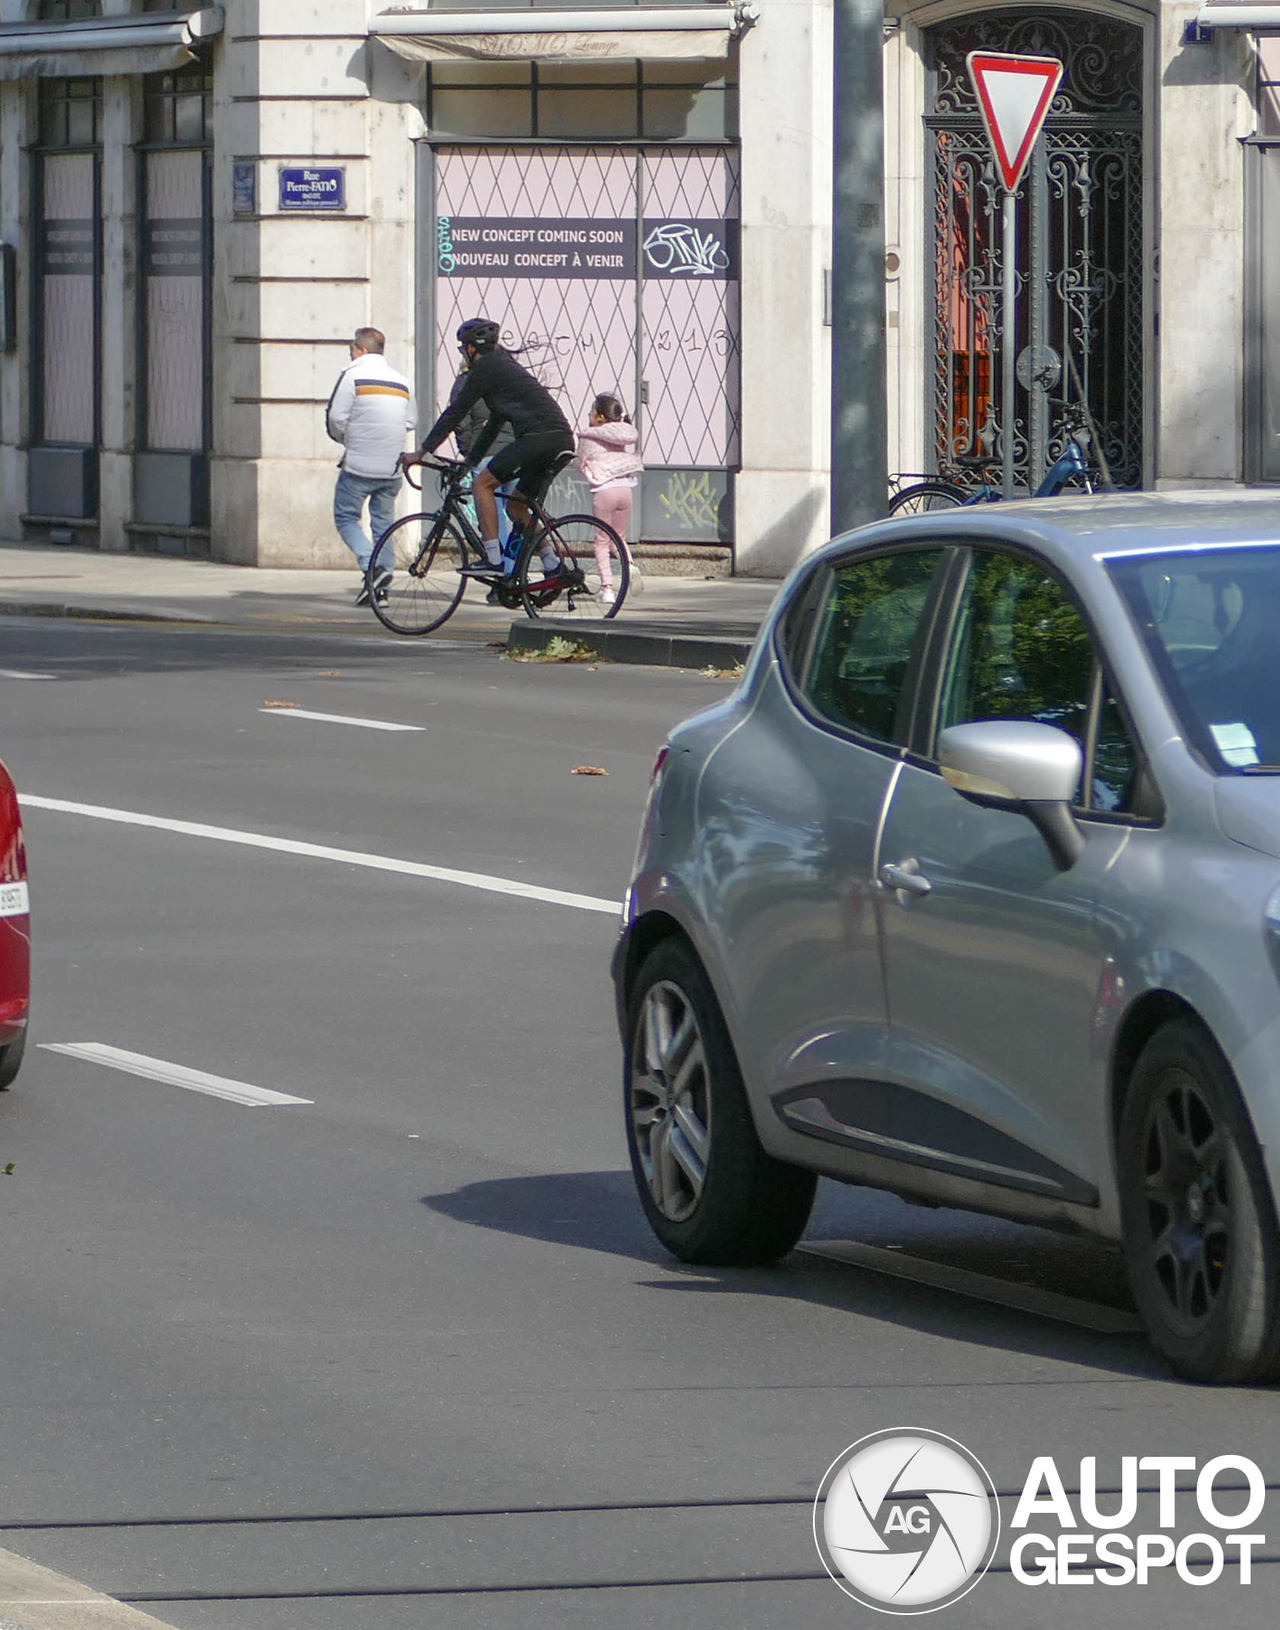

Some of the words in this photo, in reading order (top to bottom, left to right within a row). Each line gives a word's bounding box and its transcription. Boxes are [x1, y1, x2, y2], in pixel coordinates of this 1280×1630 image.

[574, 34, 620, 55] Lounge
[303, 170, 320, 180] Rue
[451, 230, 480, 242] NEW
[482, 230, 535, 242] CONCEPT
[537, 230, 587, 243] COMING
[589, 231, 624, 243] SOON
[453, 253, 509, 266] NOUVEAU
[514, 254, 568, 267] CONCEPT
[572, 252, 582, 267] À
[586, 254, 624, 267] VENIR
